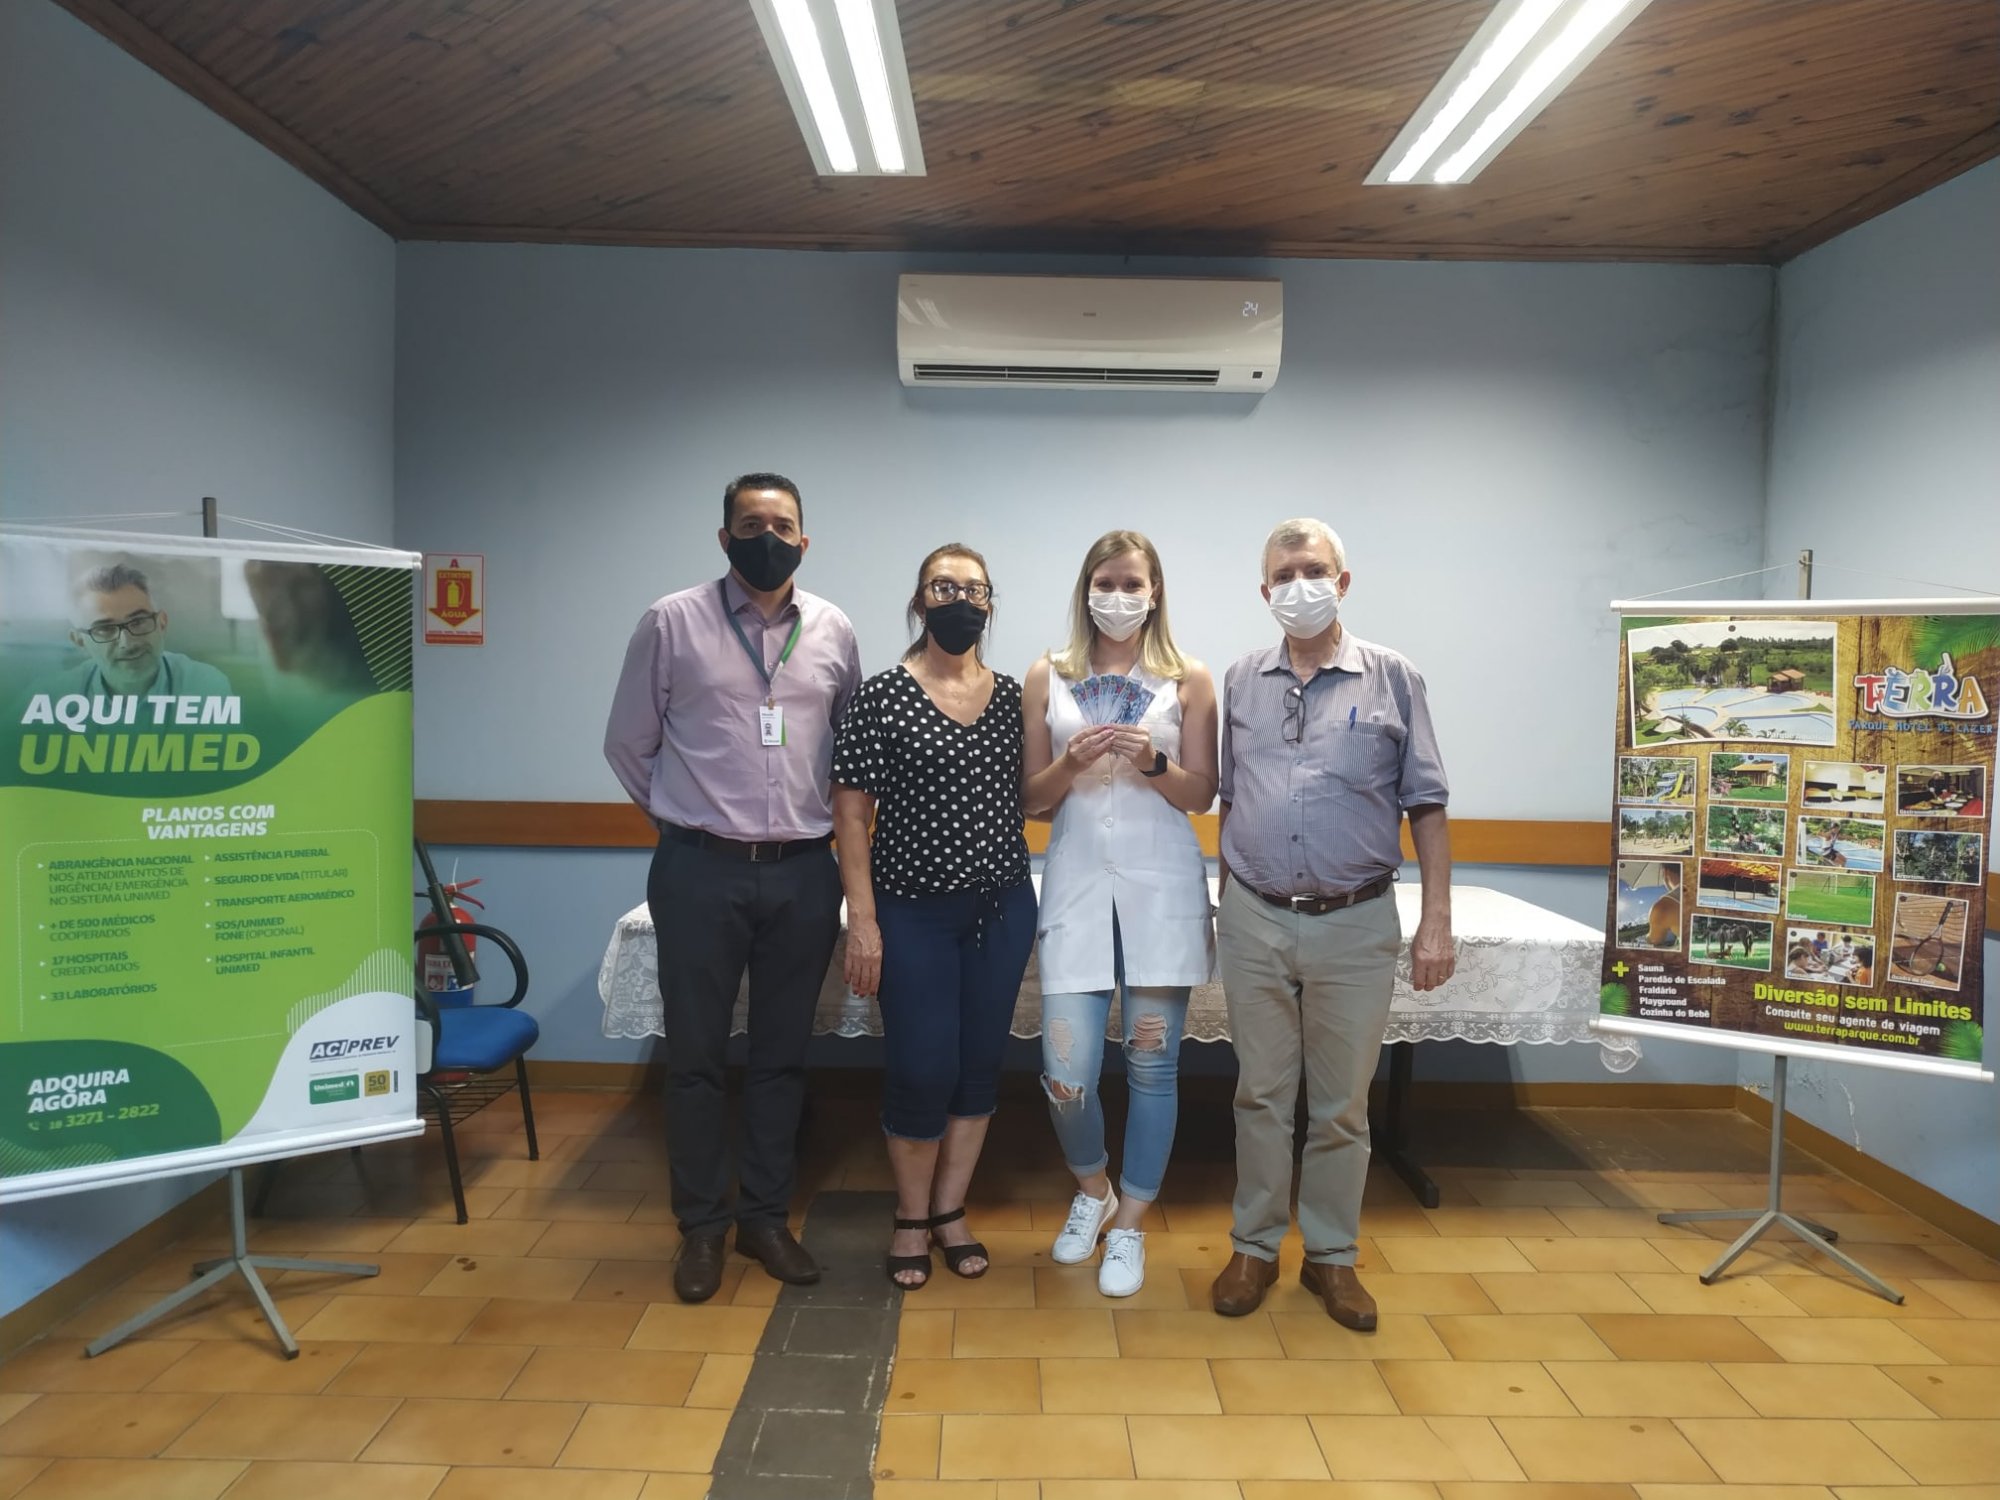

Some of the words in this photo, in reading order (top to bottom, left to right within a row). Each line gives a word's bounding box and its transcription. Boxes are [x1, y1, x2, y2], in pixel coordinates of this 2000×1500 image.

[1243, 301, 1258, 316] 24
[1855, 667, 1986, 714] TERRA
[21, 694, 138, 732] AQUI
[148, 696, 241, 725] TEM
[1850, 720, 1888, 731] PARQUE
[1895, 721, 1931, 732] HOTEL
[1937, 722, 1952, 733] DE
[1956, 723, 1993, 734] LAZER
[19, 733, 261, 775] UNIMED
[142, 806, 224, 823] PLANOS
[229, 805, 275, 820] COM
[147, 821, 267, 840] VANTAGENS
[48, 857, 134, 870] ABRANGÊNCIA
[136, 855, 194, 866] NACIONAL
[214, 850, 282, 862] ASSISTÊNCIA
[284, 848, 329, 858] FUNERAL
[49, 872, 75, 883] NOS
[76, 868, 169, 882] ATENDIMENTOS
[170, 867, 184, 876] DE
[214, 873, 259, 885] SEGURO
[261, 872, 275, 882] DE
[275, 871, 300, 881] VIDA
[115, 878, 188, 892] EMERGÊNCIA
[49, 897, 68, 906] NO
[70, 893, 122, 905] SISTEMA
[124, 890, 170, 902] UNIMED
[215, 895, 287, 907] TRANSPORTE
[288, 889, 355, 902] AEROMÉDICO
[59, 919, 74, 929] DE
[76, 918, 100, 929] 500
[101, 914, 156, 926] MÉDICOS
[50, 928, 131, 942] COOPERADOS
[215, 931, 244, 941] FONE
[246, 926, 304, 940] (OPCIONAL)
[67, 951, 128, 964] HOSPITAIS
[215, 951, 268, 963] HOSPITAL
[270, 947, 315, 959] INFANTIL
[50, 962, 140, 977] CREDENCIADOS
[216, 963, 260, 975] UNIMED
[1637, 963, 1664, 973] Sauna
[1638, 975, 1673, 984] Paredão
[1674, 976, 1686, 984] de
[1687, 976, 1726, 985] Escalada
[51, 991, 65, 1001] 33
[67, 983, 157, 1000] LABORATÓRIOS
[1639, 985, 1677, 995] Fraldário
[1639, 997, 1687, 1007] Playground
[1754, 983, 1839, 1008] Diversão
[1845, 995, 1887, 1012] sem
[1894, 996, 1972, 1021] Limites
[1640, 1008, 1673, 1017] Cozinha
[1675, 1009, 1686, 1017] do
[1688, 1009, 1710, 1018] Bebê
[1765, 1005, 1811, 1021] Consulte
[1815, 1012, 1835, 1024] seu
[1839, 1014, 1877, 1029] agente
[1881, 1018, 1895, 1030] de
[1900, 1019, 1941, 1036] viagem
[1784, 1021, 1920, 1046] www.terraparque.com.br
[27, 1068, 130, 1096] ADQUIRA
[368, 1074, 386, 1087] 50
[28, 1089, 107, 1114] AGORA
[65, 1111, 103, 1127] 3271
[118, 1103, 160, 1120] 2822
